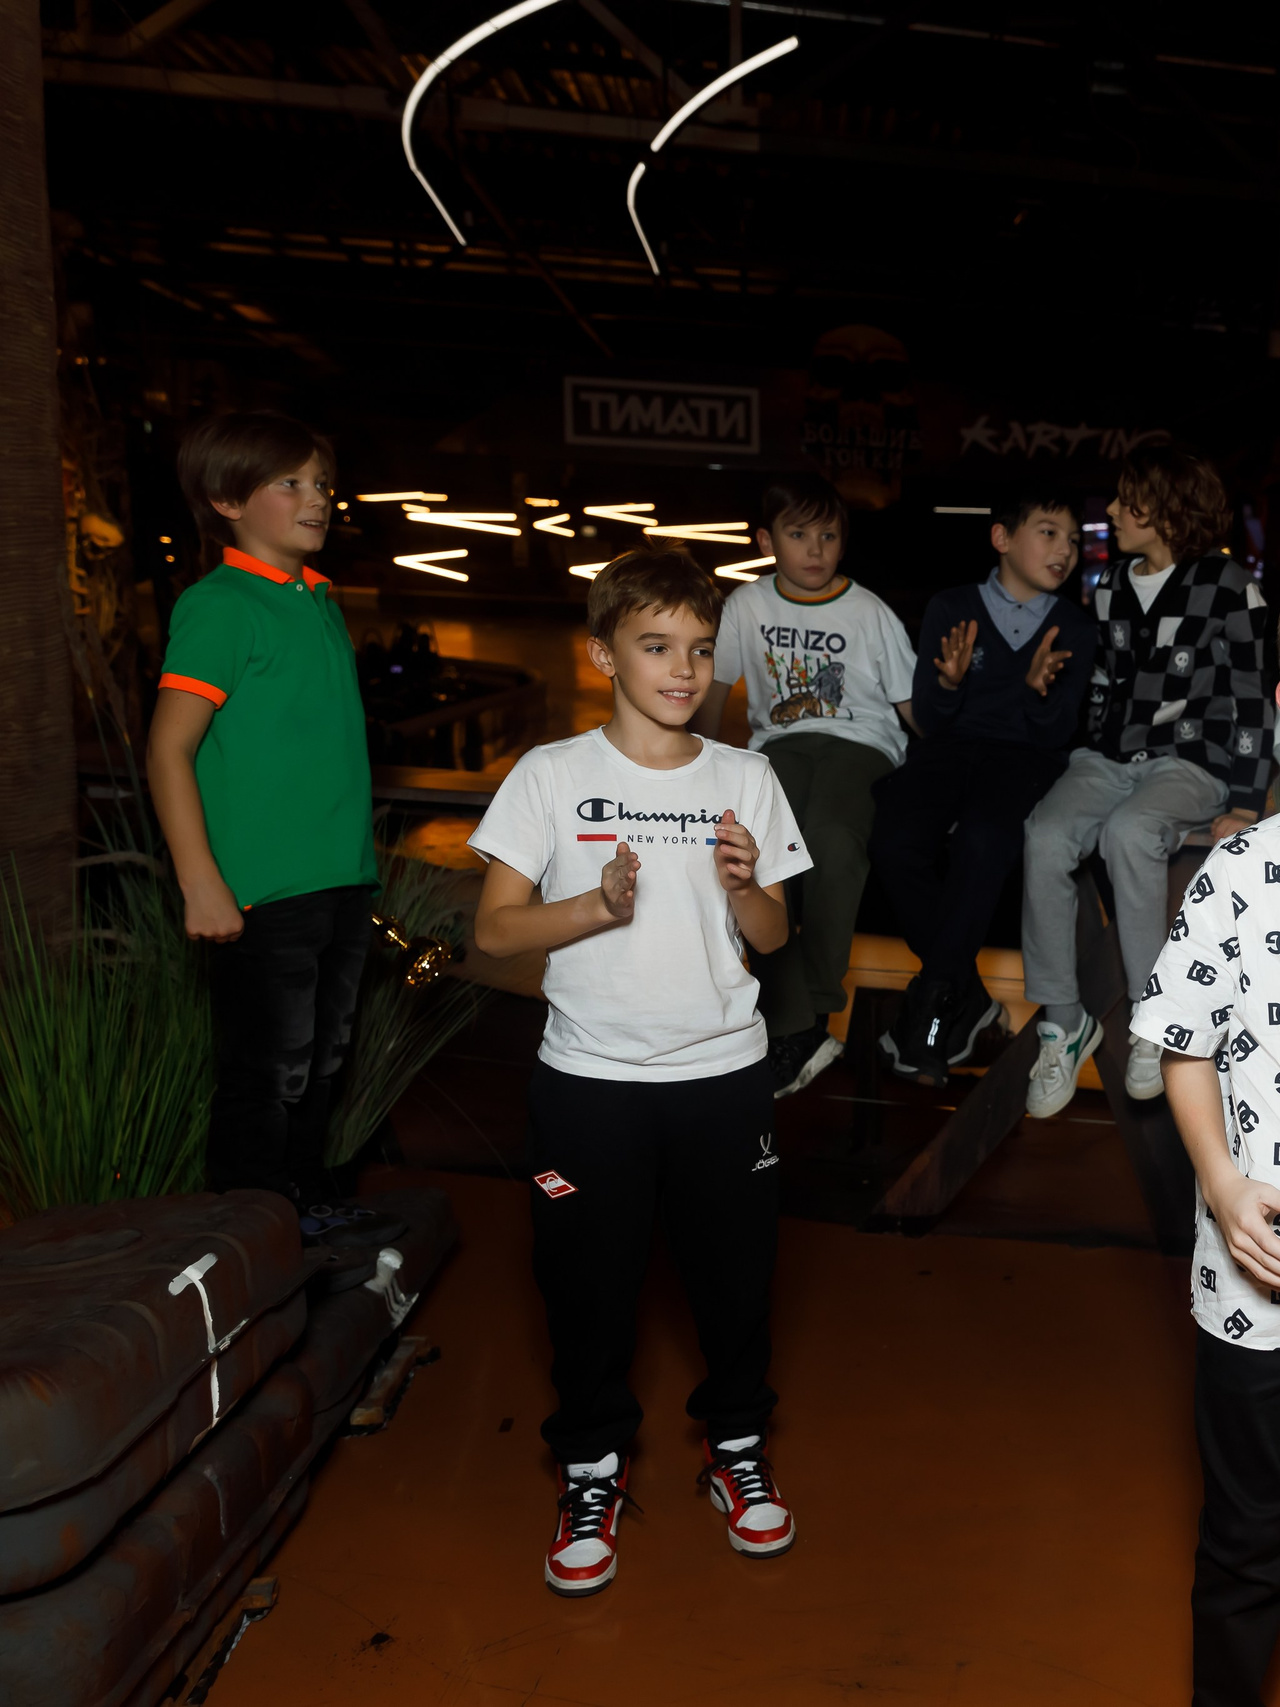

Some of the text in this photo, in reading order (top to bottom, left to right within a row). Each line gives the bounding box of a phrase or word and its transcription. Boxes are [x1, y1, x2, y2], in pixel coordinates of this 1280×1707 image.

[578, 390, 748, 440] ТИМАТИ
[760, 624, 847, 654] KENZO
[626, 834, 698, 845] NEW YORK
[1187, 960, 1219, 986] DG
[1162, 1024, 1195, 1052] DG
[1231, 1029, 1260, 1063] DG
[1223, 1307, 1254, 1340] DG
